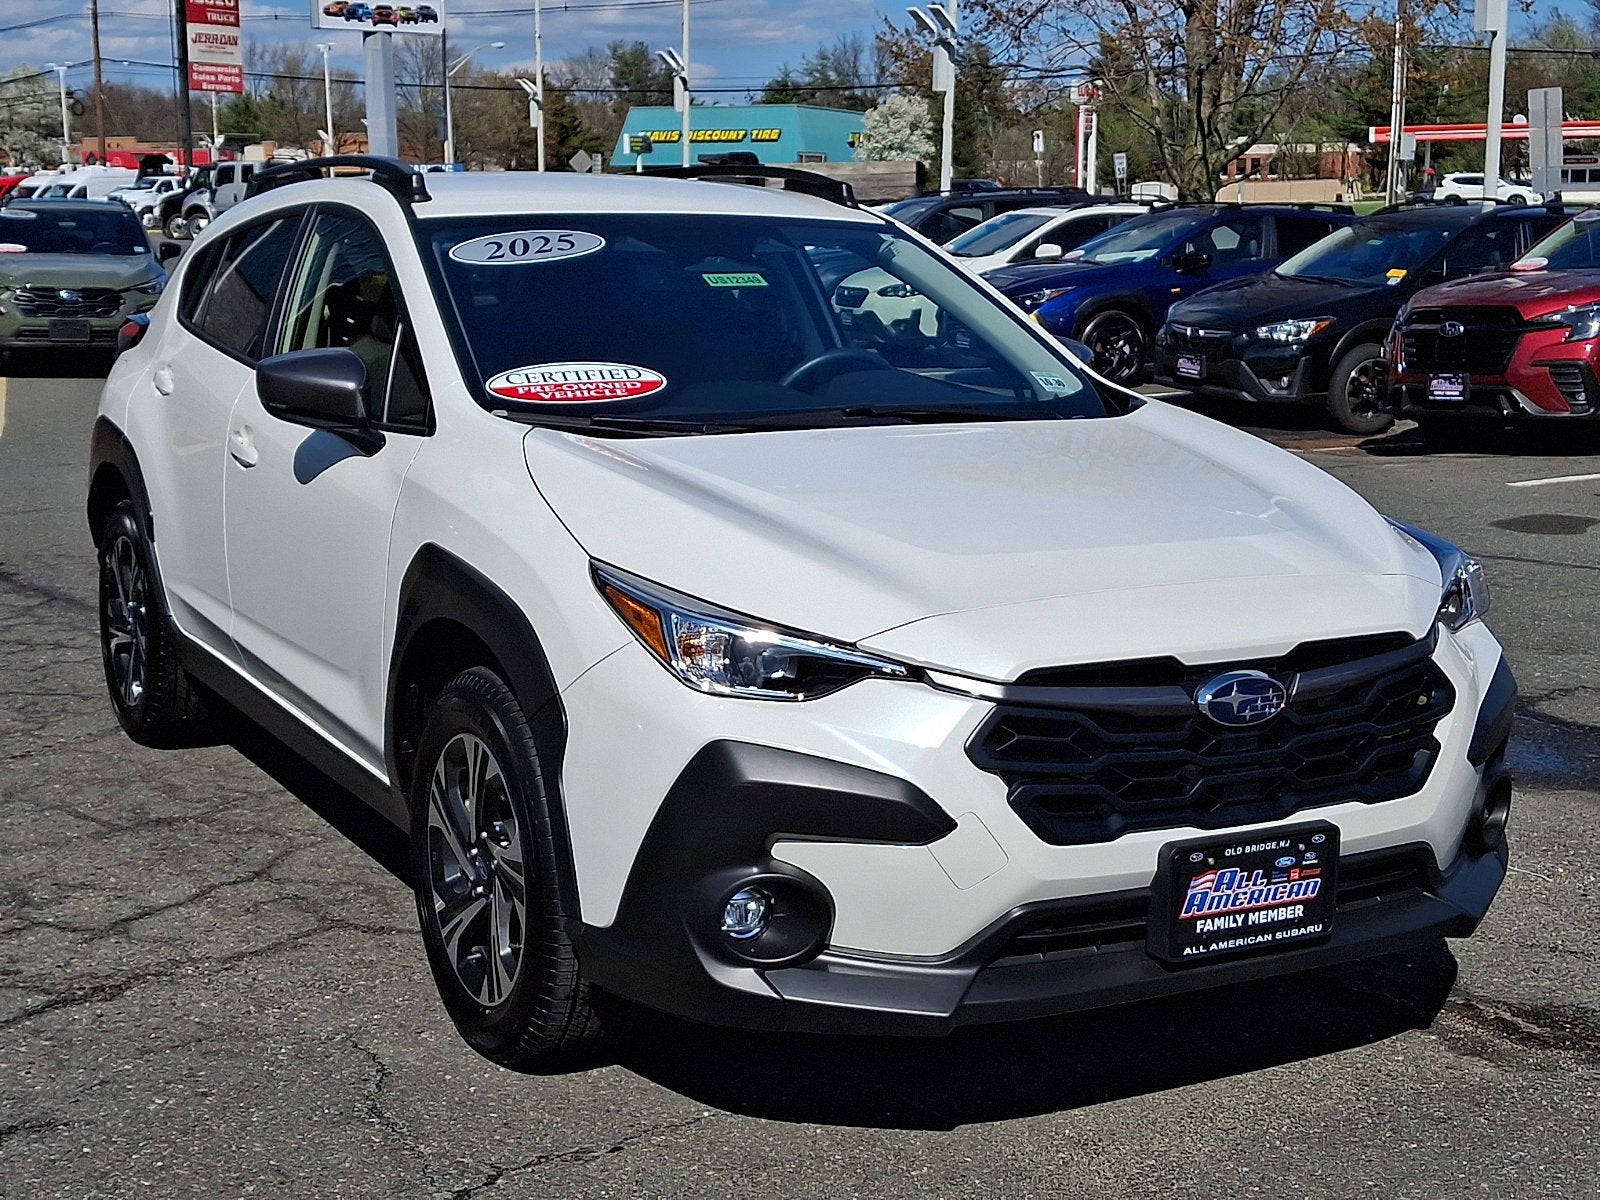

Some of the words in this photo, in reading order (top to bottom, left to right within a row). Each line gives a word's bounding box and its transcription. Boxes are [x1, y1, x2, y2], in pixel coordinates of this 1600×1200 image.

[206, 12, 235, 22] TRUCK
[192, 63, 239, 73] Commercial
[192, 72, 216, 81] Sales
[217, 74, 240, 82] Parts
[201, 82, 233, 90] Service
[645, 130, 681, 142] AVIS
[750, 129, 781, 141] TIRE
[484, 233, 576, 260] 2025
[505, 368, 642, 385] CERTIFIED
[516, 381, 642, 394] PRE-OWNED
[537, 388, 628, 400] VEHICLE
[1225, 846, 1243, 857] OLD
[1196, 914, 1245, 933] FAMILY
[1248, 904, 1304, 925] MEMBER
[1183, 945, 1207, 956] ALL
[1209, 933, 1273, 951] AMERICAN
[1275, 923, 1323, 939] SUBARU
